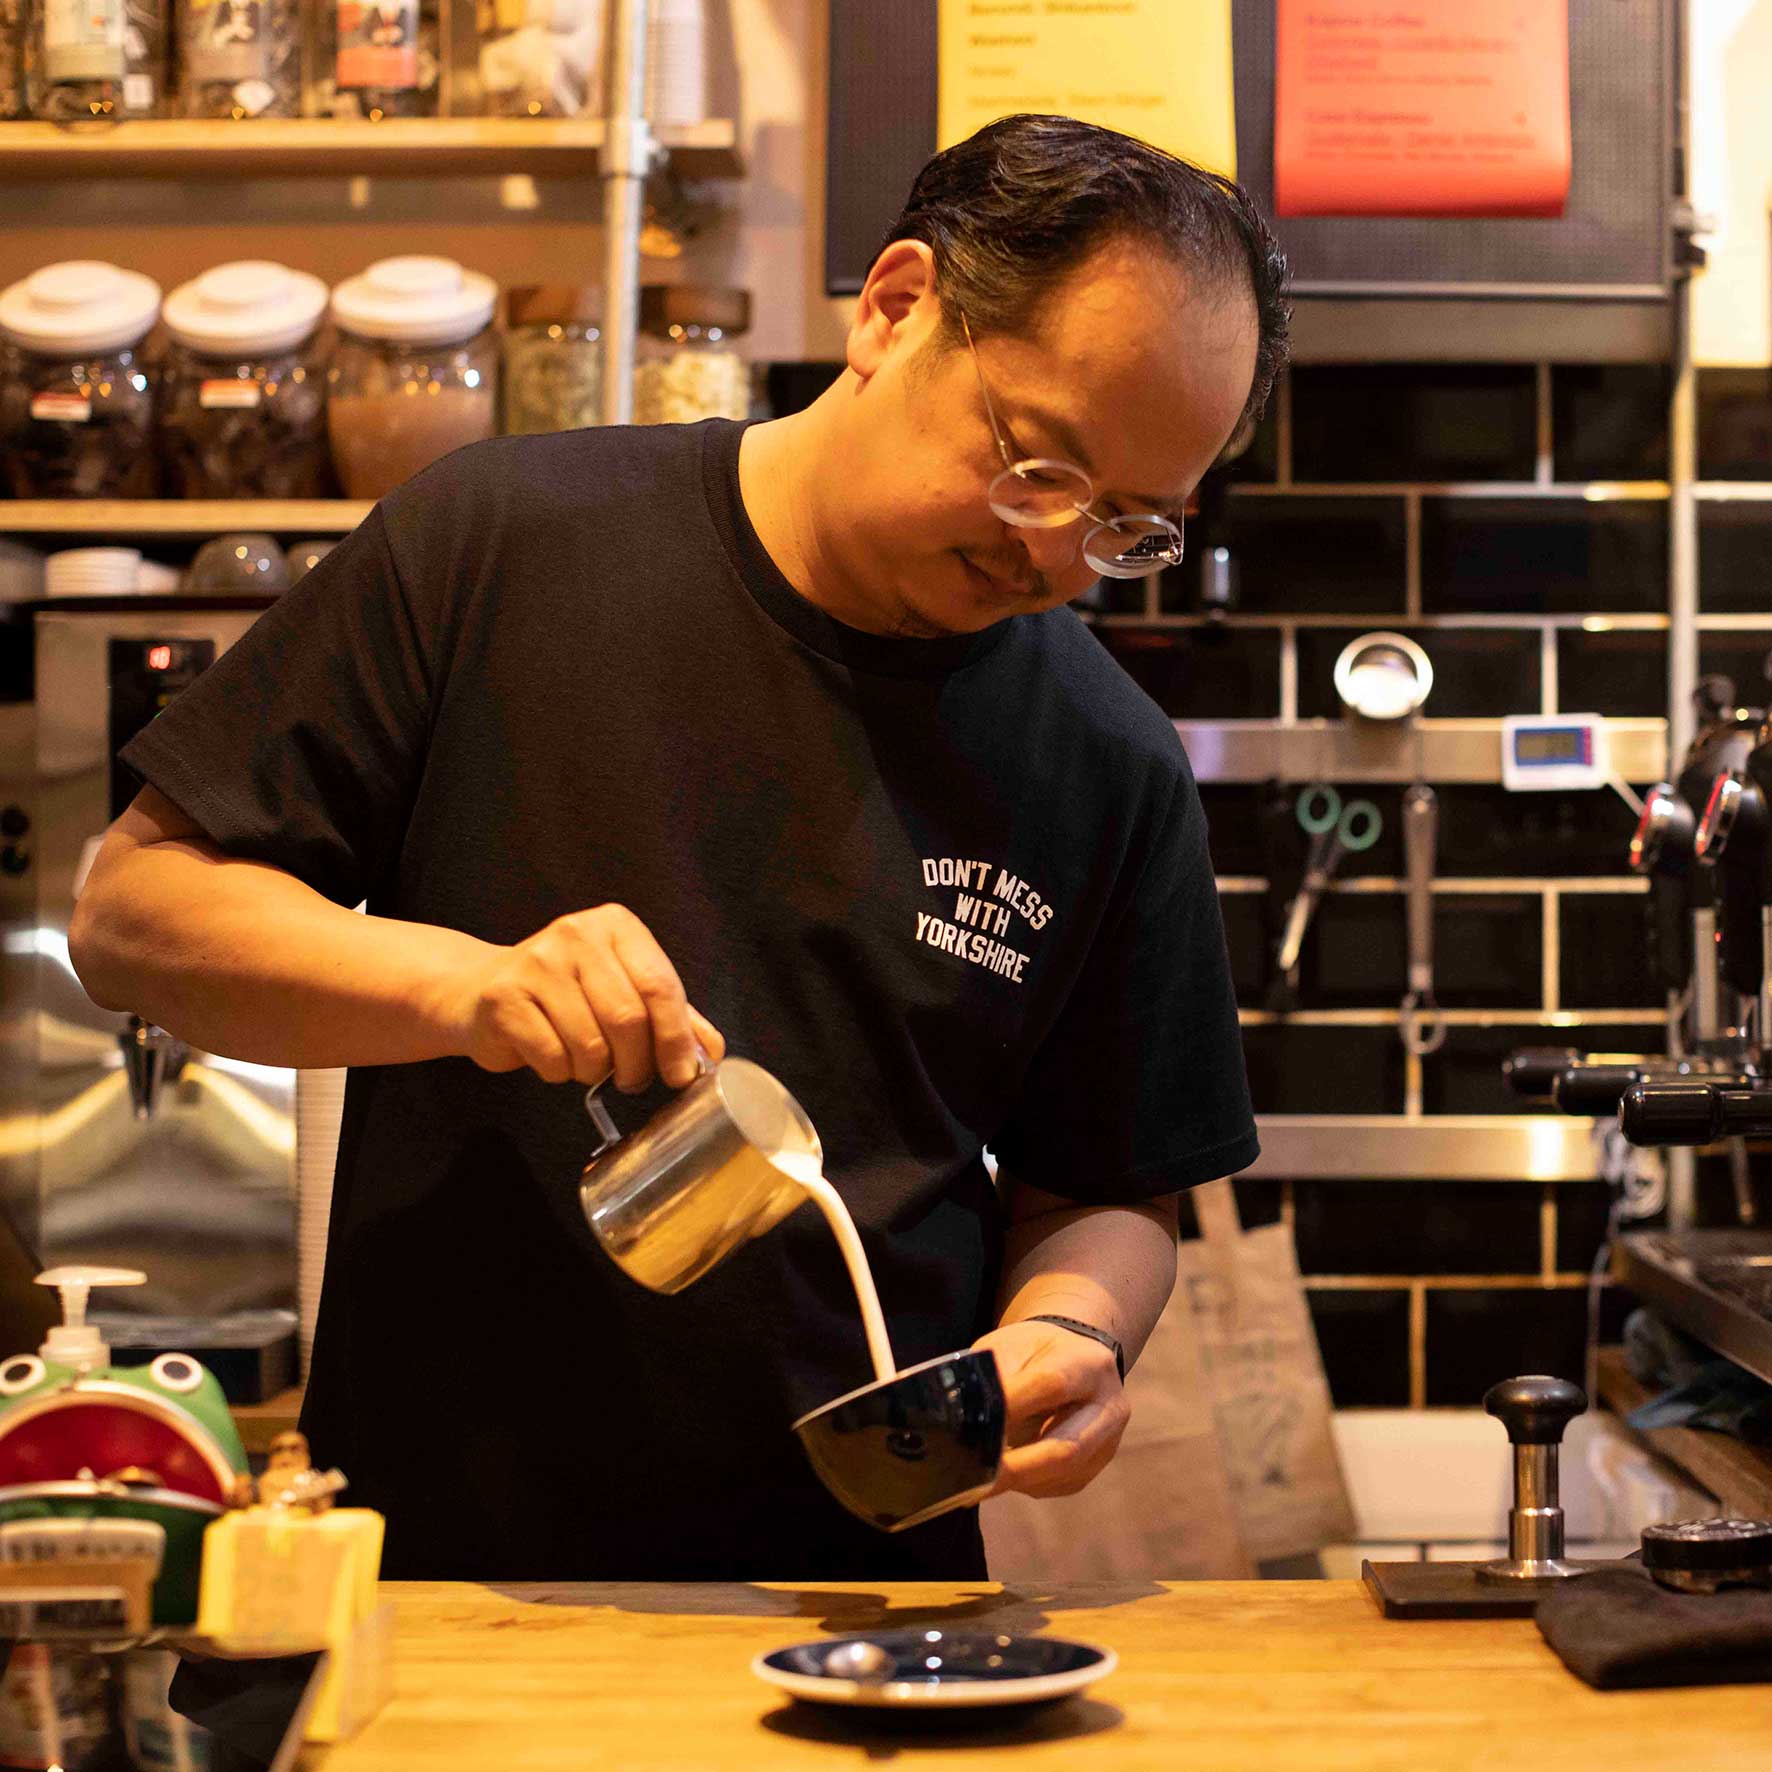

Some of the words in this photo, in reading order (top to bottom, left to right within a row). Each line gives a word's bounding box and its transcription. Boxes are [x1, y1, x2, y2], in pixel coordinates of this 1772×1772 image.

[922, 858, 992, 891] DON'T
[992, 869, 1054, 930] MESS
[954, 893, 1011, 937] WITH
[915, 912, 1031, 983] YORKSHIRE
